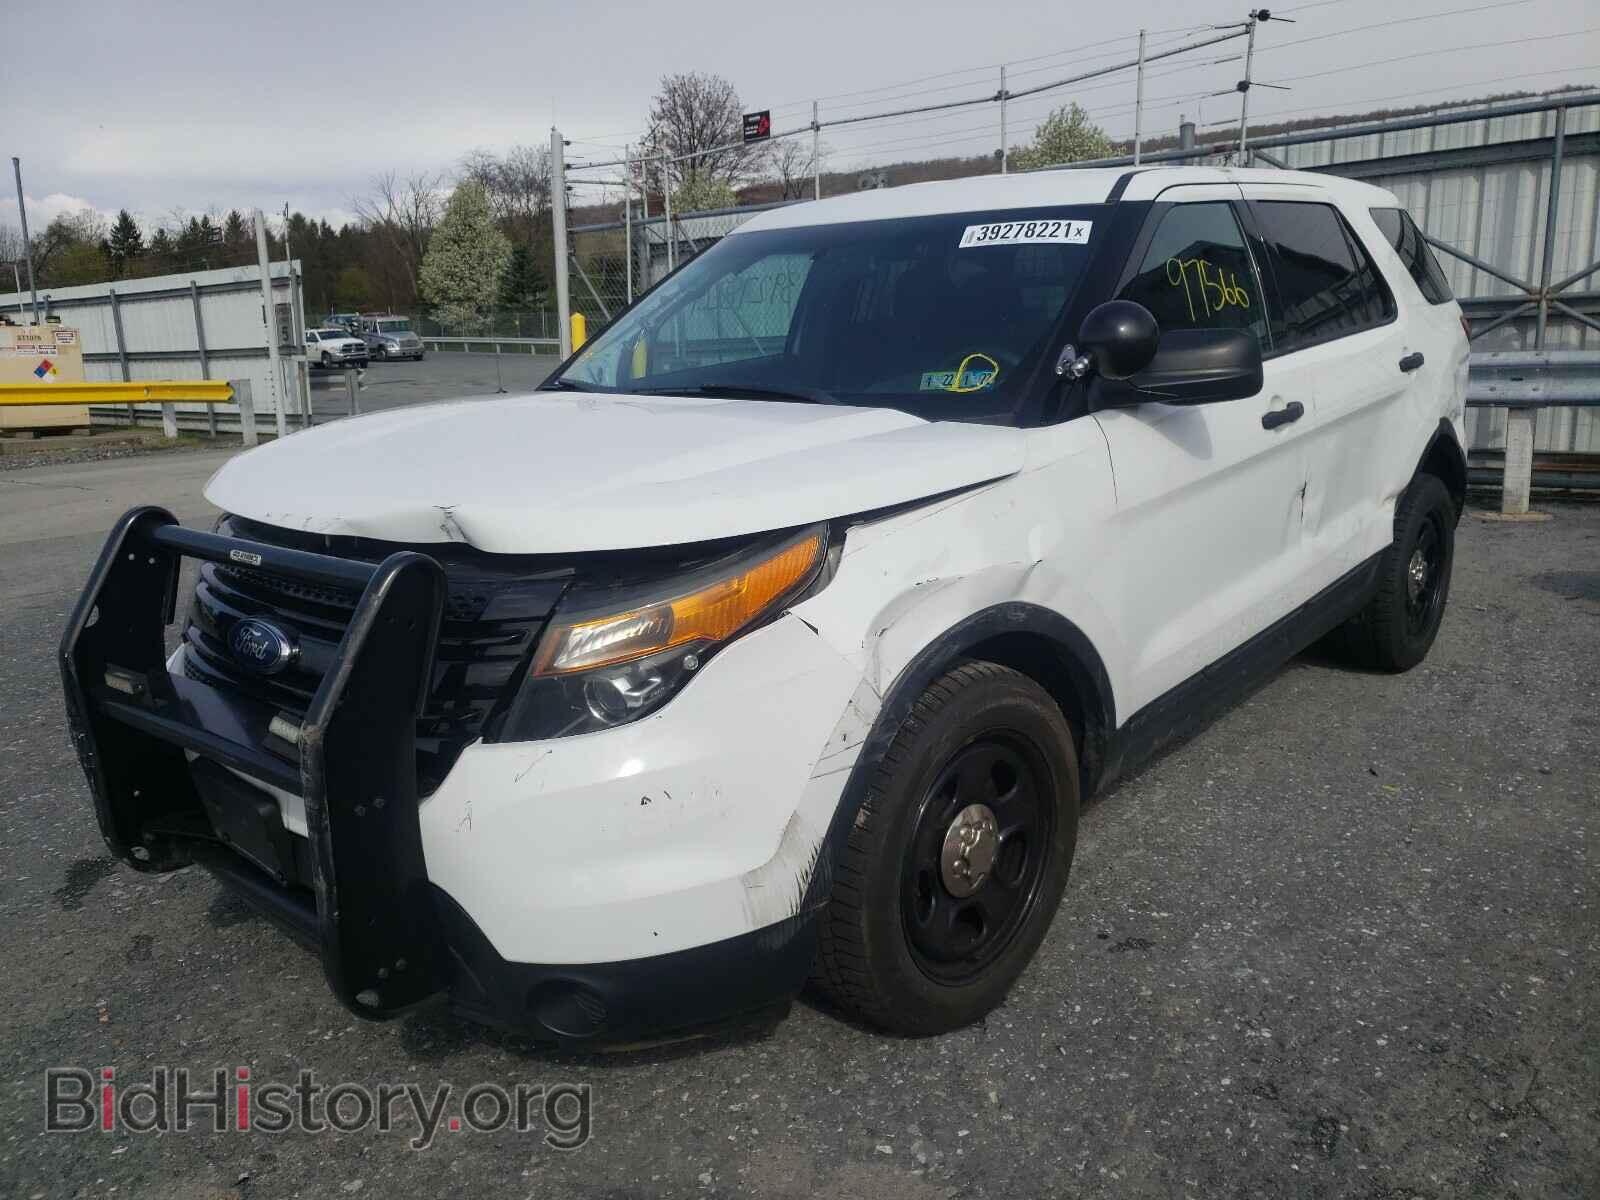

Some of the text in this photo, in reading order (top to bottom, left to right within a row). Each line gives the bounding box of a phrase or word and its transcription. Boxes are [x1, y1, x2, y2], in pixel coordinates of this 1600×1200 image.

[977, 222, 1072, 241] 39278221
[1166, 258, 1249, 321] 97566
[240, 626, 269, 660] Ford
